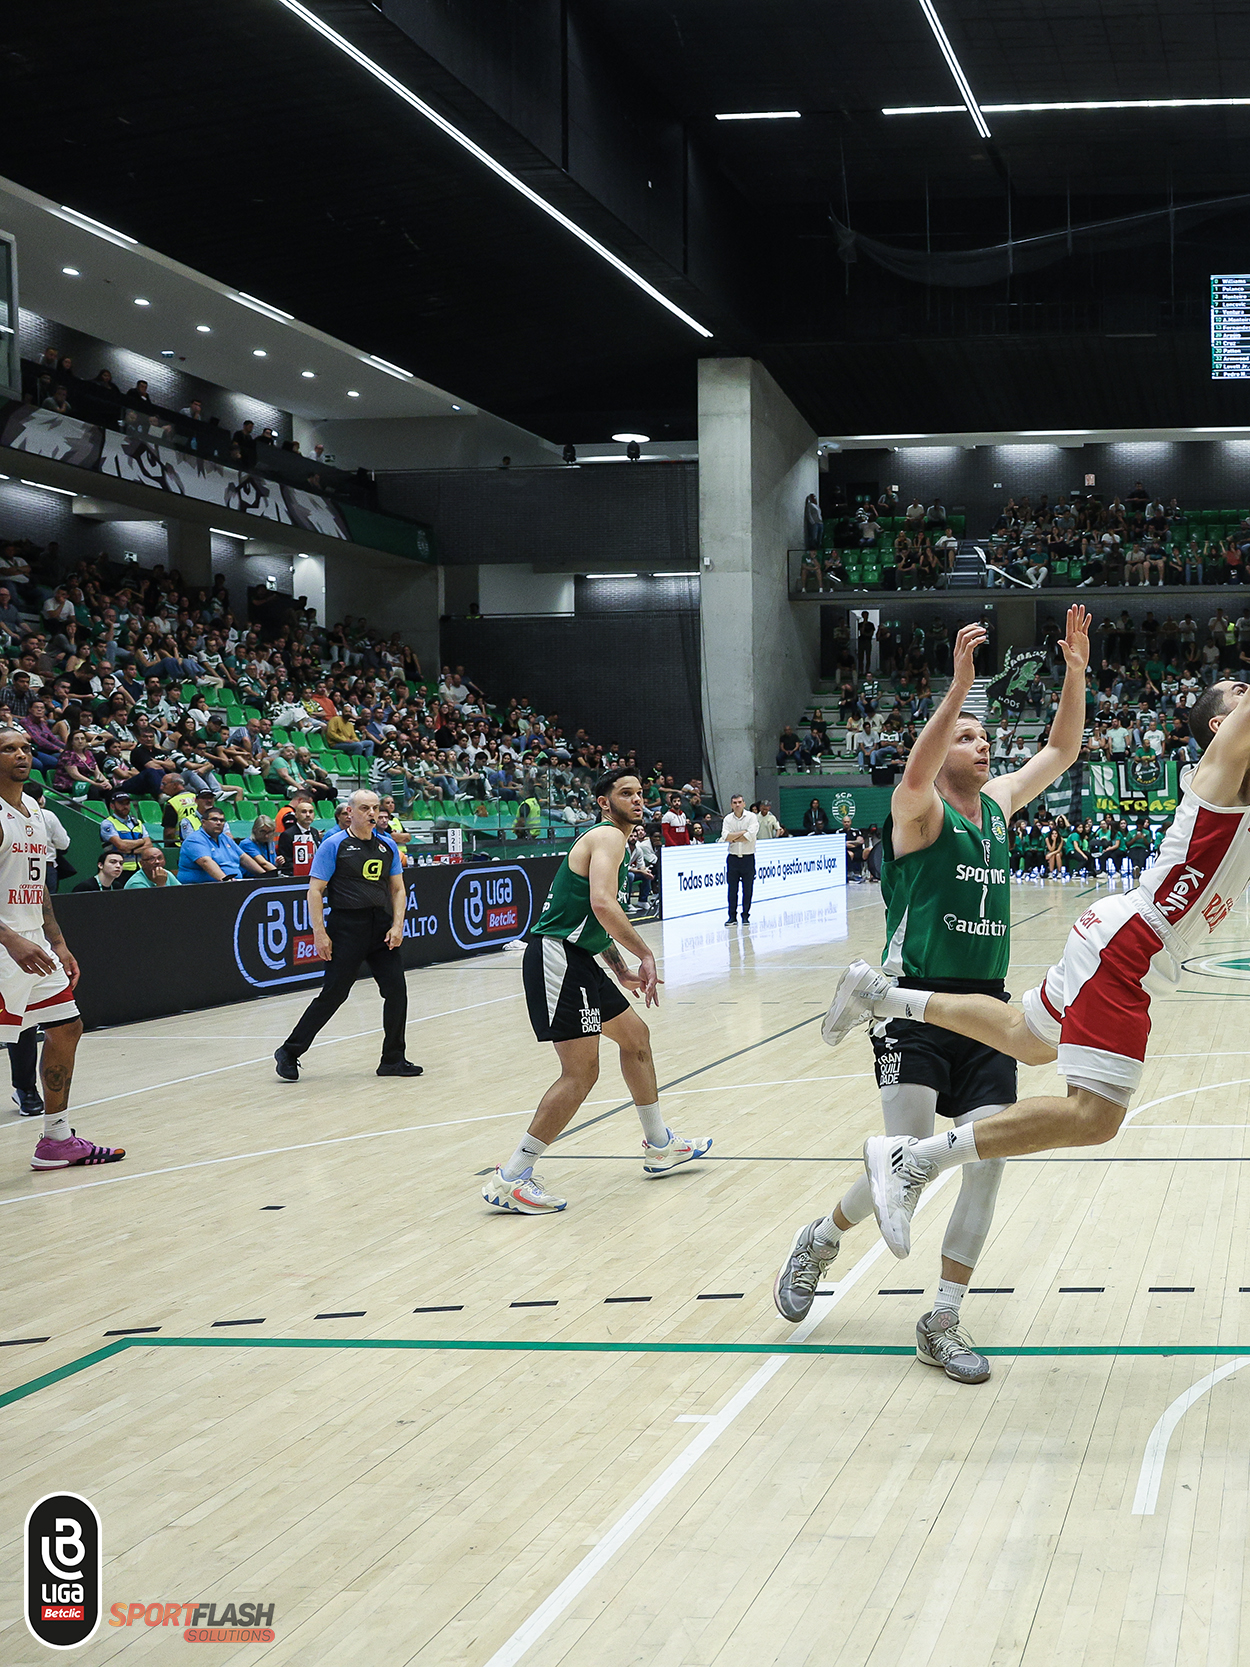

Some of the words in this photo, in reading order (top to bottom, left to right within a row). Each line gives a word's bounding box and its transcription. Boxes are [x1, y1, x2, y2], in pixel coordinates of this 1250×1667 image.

[1096, 798, 1176, 812] ULTRAS
[12, 842, 23, 853] SL
[28, 857, 40, 881] 15
[758, 860, 776, 884] apoio
[777, 859, 782, 876] à
[782, 858, 803, 880] gestão
[803, 860, 815, 873] num
[816, 855, 823, 871] só
[678, 871, 703, 891] Todas
[704, 874, 714, 888] as
[1155, 865, 1205, 917] Kelly
[489, 908, 516, 927] Betclic
[955, 918, 1007, 937] auditiv
[580, 986, 589, 1009] 1
[579, 1008, 600, 1017] TRAN
[582, 1024, 602, 1034] DADE
[880, 1062, 901, 1075] QUILI
